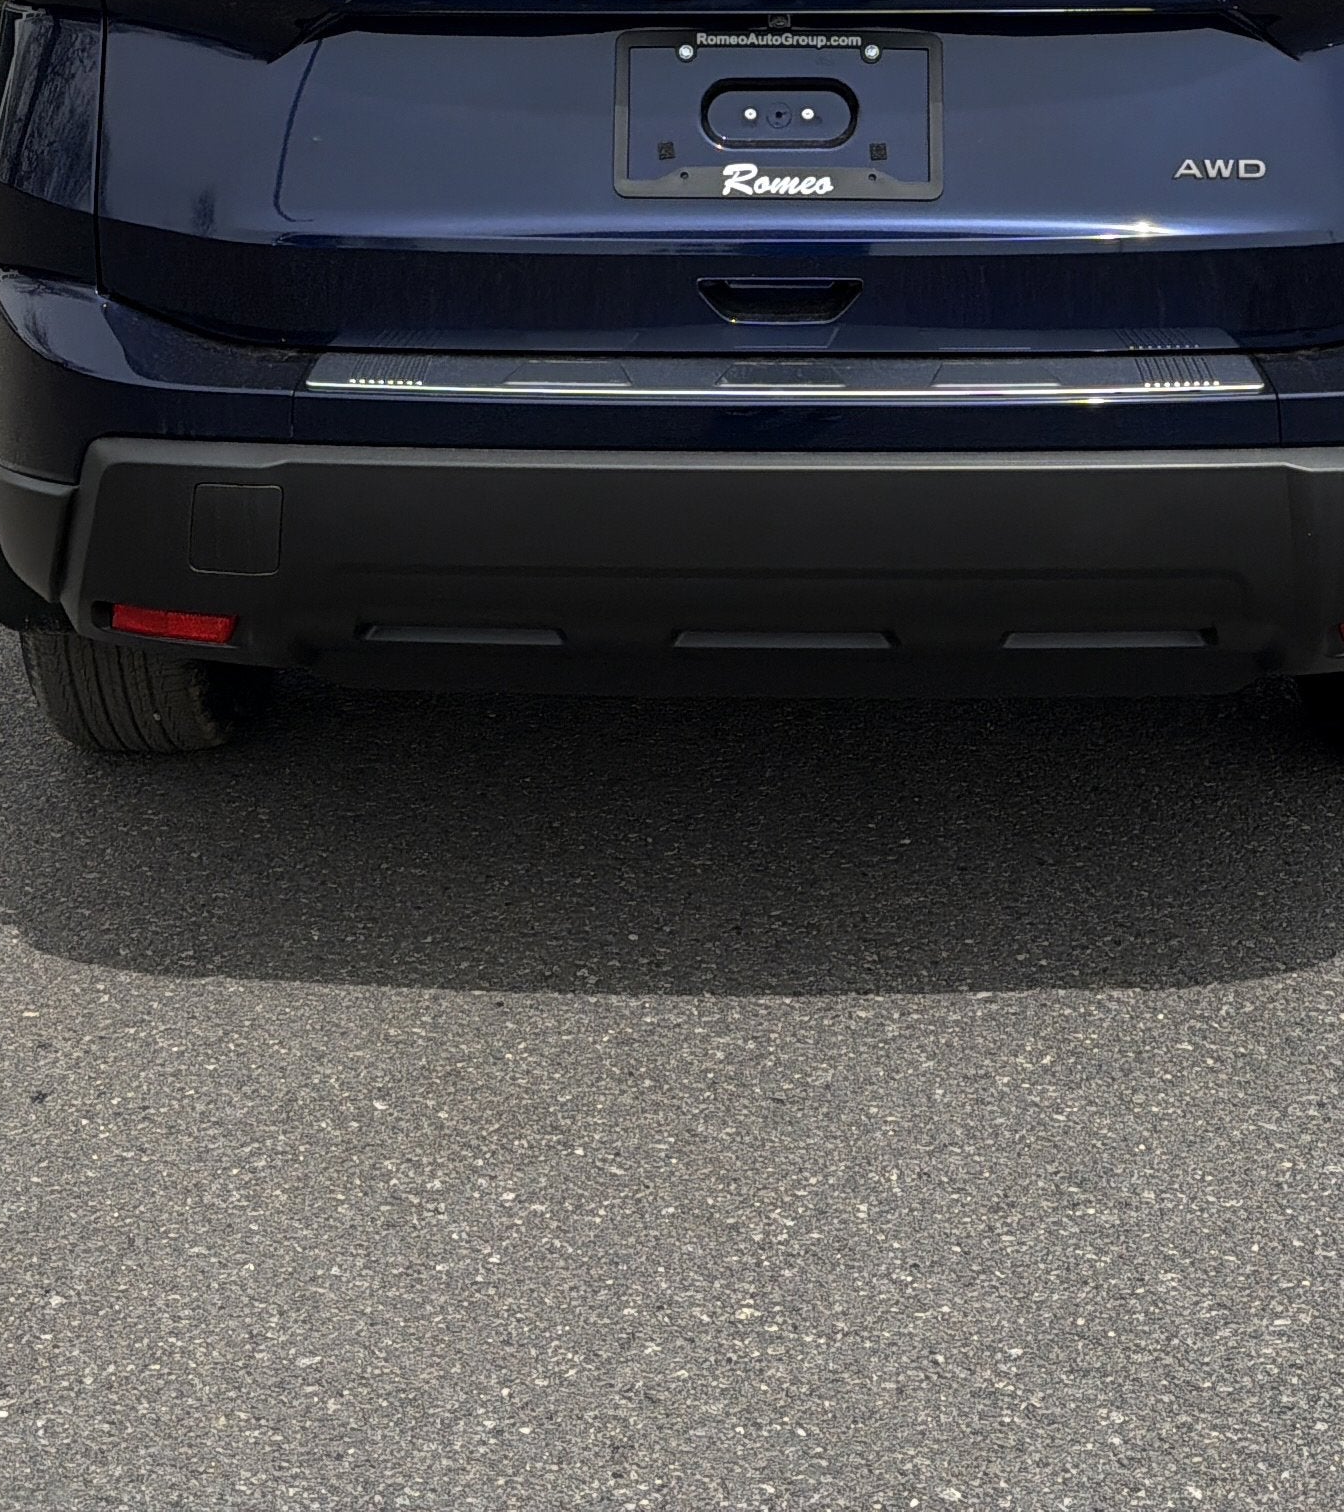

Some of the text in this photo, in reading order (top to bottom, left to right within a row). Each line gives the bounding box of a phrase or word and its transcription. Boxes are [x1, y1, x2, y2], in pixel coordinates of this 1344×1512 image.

[696, 32, 862, 49] RomeoAutoGroup.com
[1173, 159, 1266, 179] AWD
[722, 163, 834, 196] Romeo
